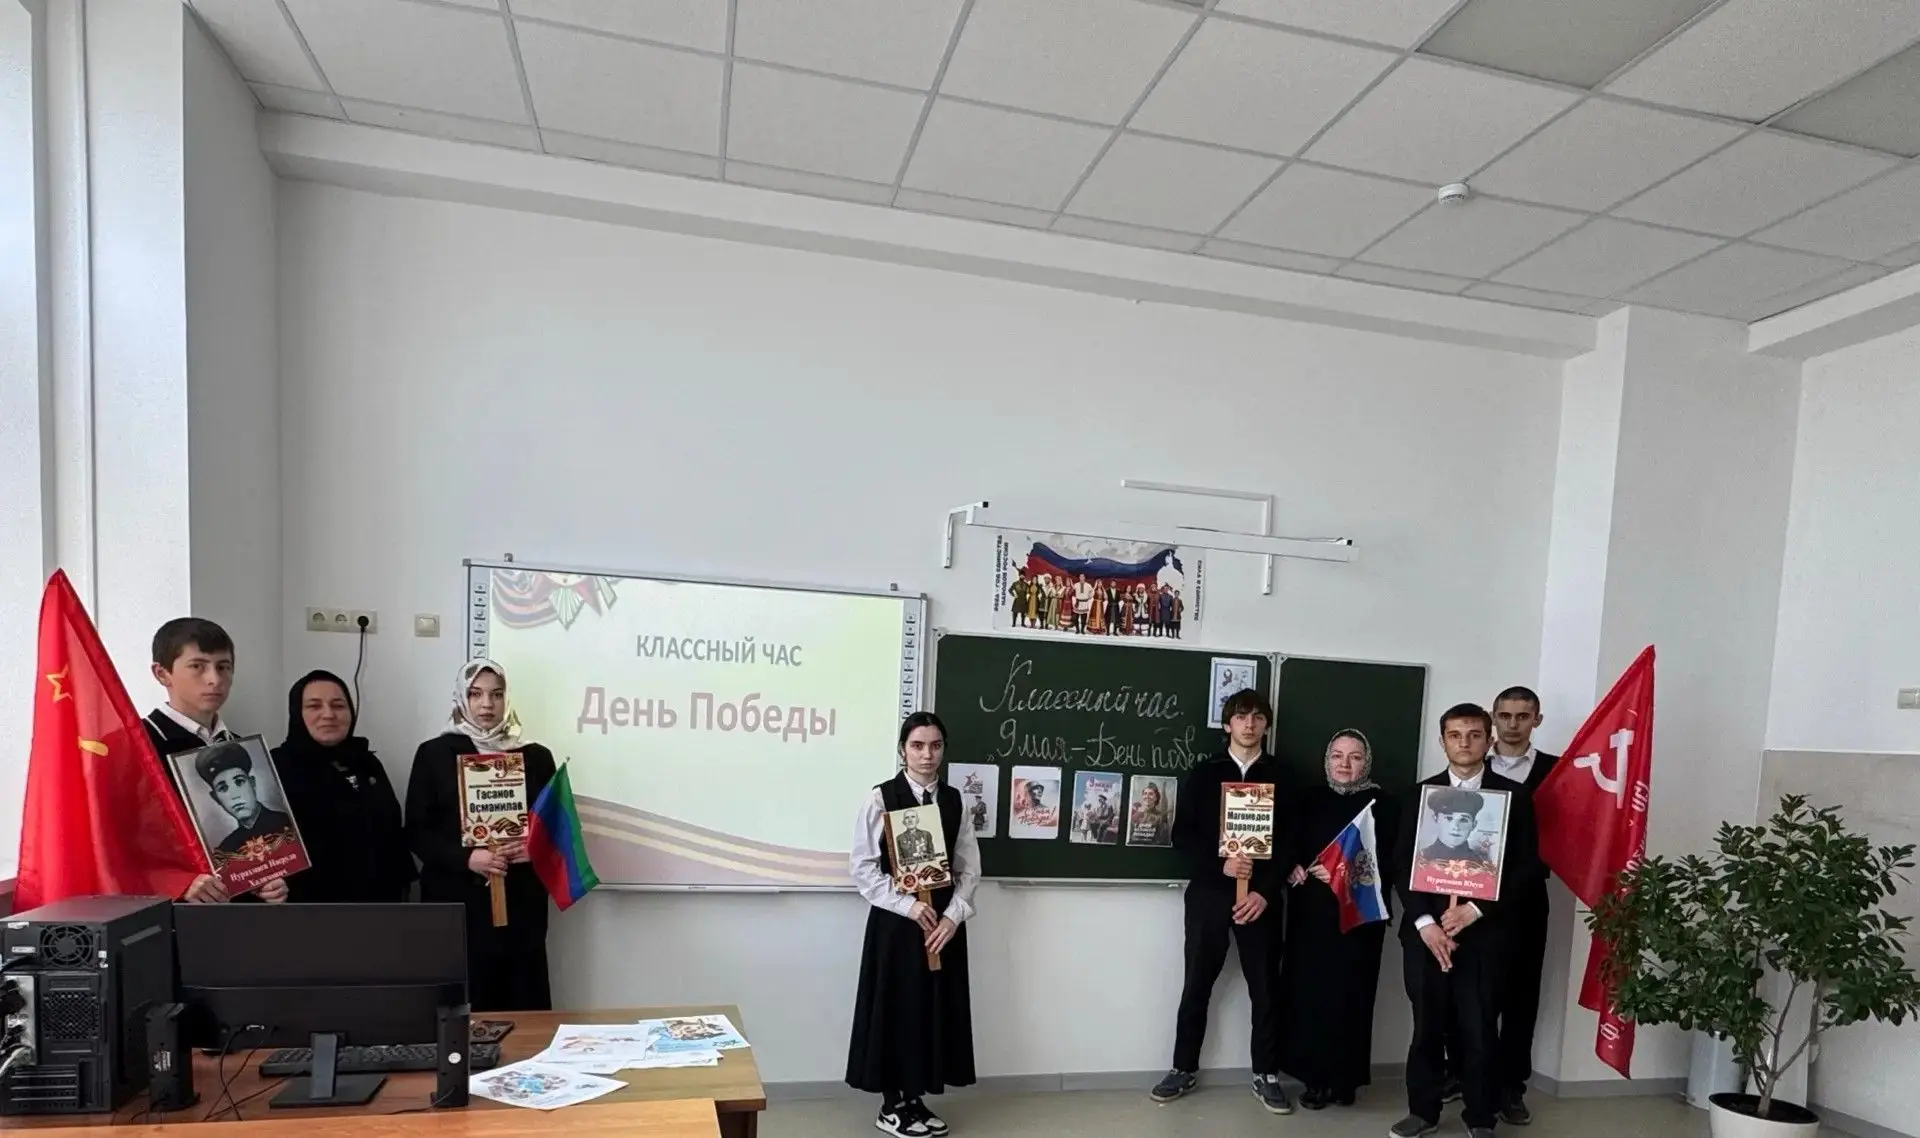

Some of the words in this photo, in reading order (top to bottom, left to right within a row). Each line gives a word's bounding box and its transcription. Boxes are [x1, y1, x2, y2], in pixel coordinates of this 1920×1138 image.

[636, 635, 755, 664] КЛАССНЫЙ
[762, 644, 802, 667] ЧАС
[979, 653, 1131, 713] Классный
[577, 686, 677, 735] День
[690, 692, 836, 743] Победы
[1085, 721, 1147, 768] День
[476, 788, 515, 800] Гасанов
[1226, 822, 1271, 833] Шарапудин
[1227, 811, 1271, 822] Магомедов
